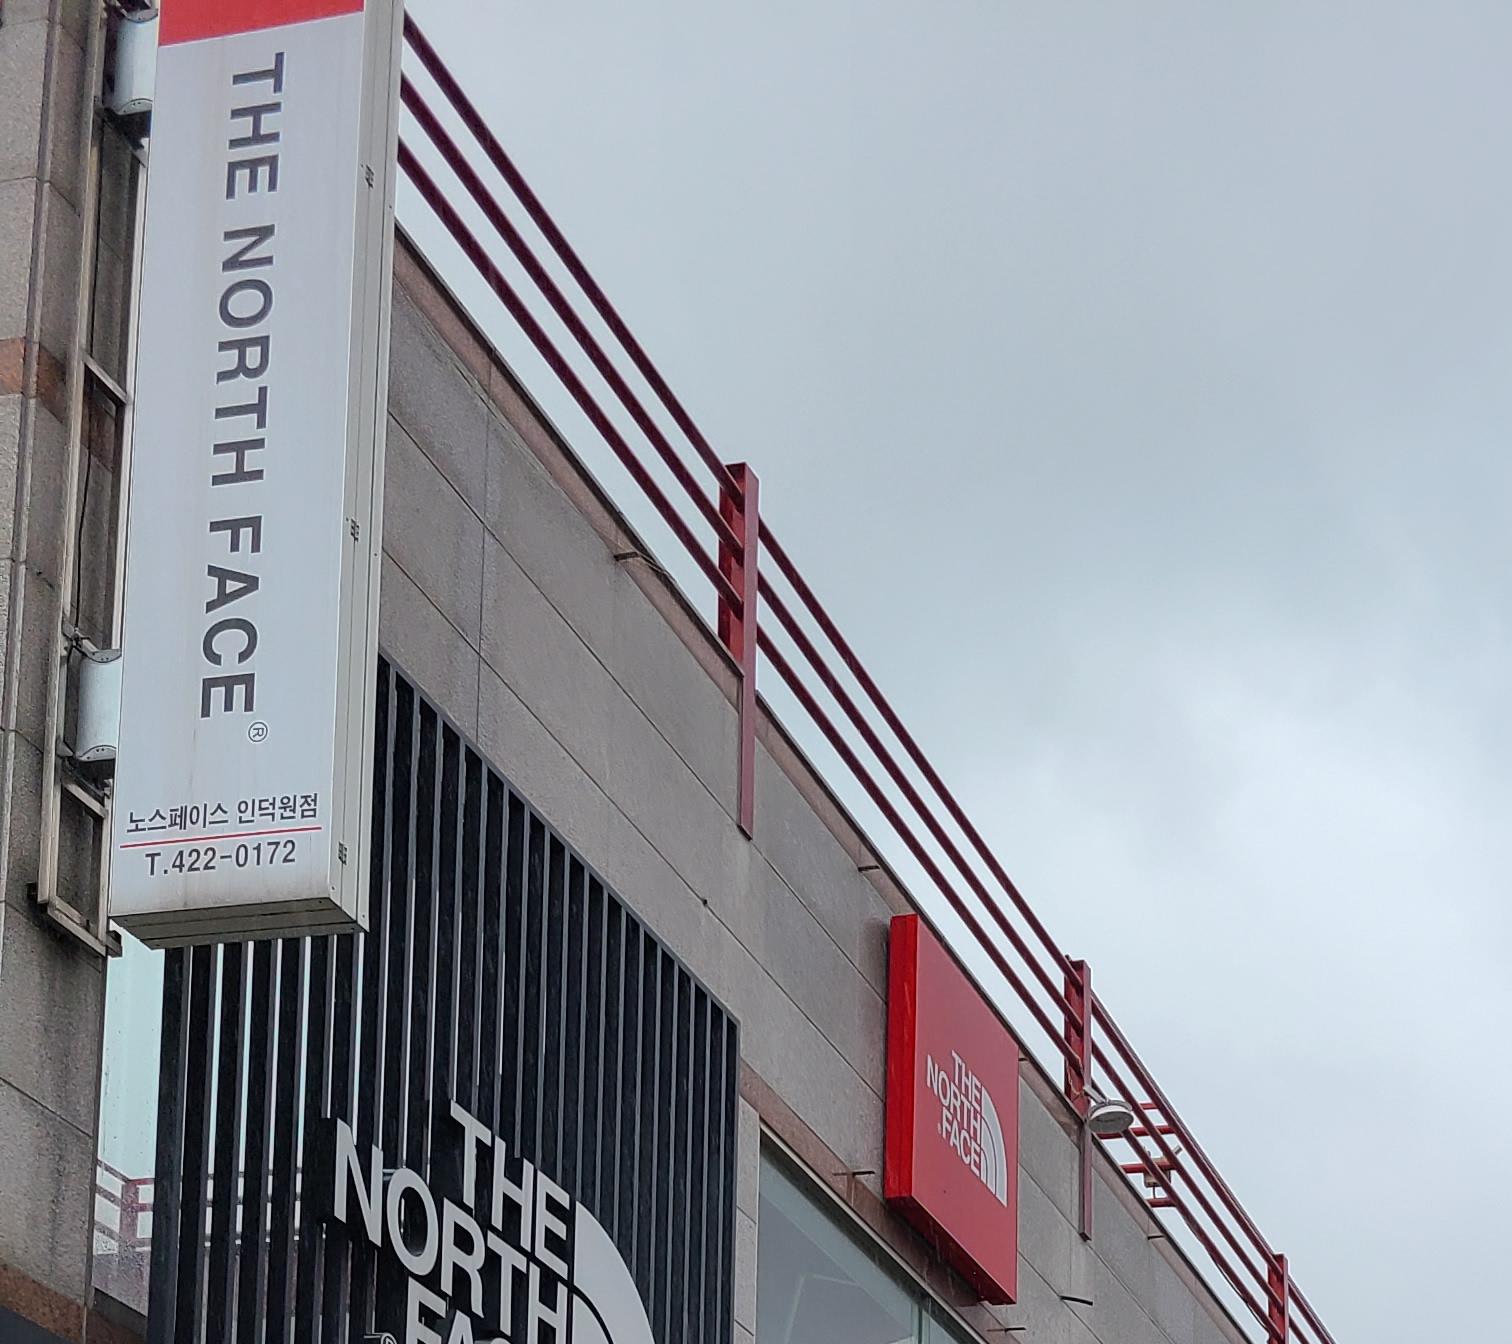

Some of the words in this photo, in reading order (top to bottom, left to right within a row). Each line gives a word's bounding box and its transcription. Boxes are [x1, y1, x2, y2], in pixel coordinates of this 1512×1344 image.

[226, 52, 285, 201] THE
[211, 223, 275, 488] NORTH
[200, 518, 263, 721] FACE
[126, 802, 229, 833] 노스페이스
[236, 792, 319, 824] 인덕원점
[145, 839, 296, 876] T.422-0172
[926, 1054, 981, 1145] NORTH
[950, 1050, 981, 1113] THE
[942, 1106, 980, 1177] FACE
[450, 1099, 571, 1282] THE
